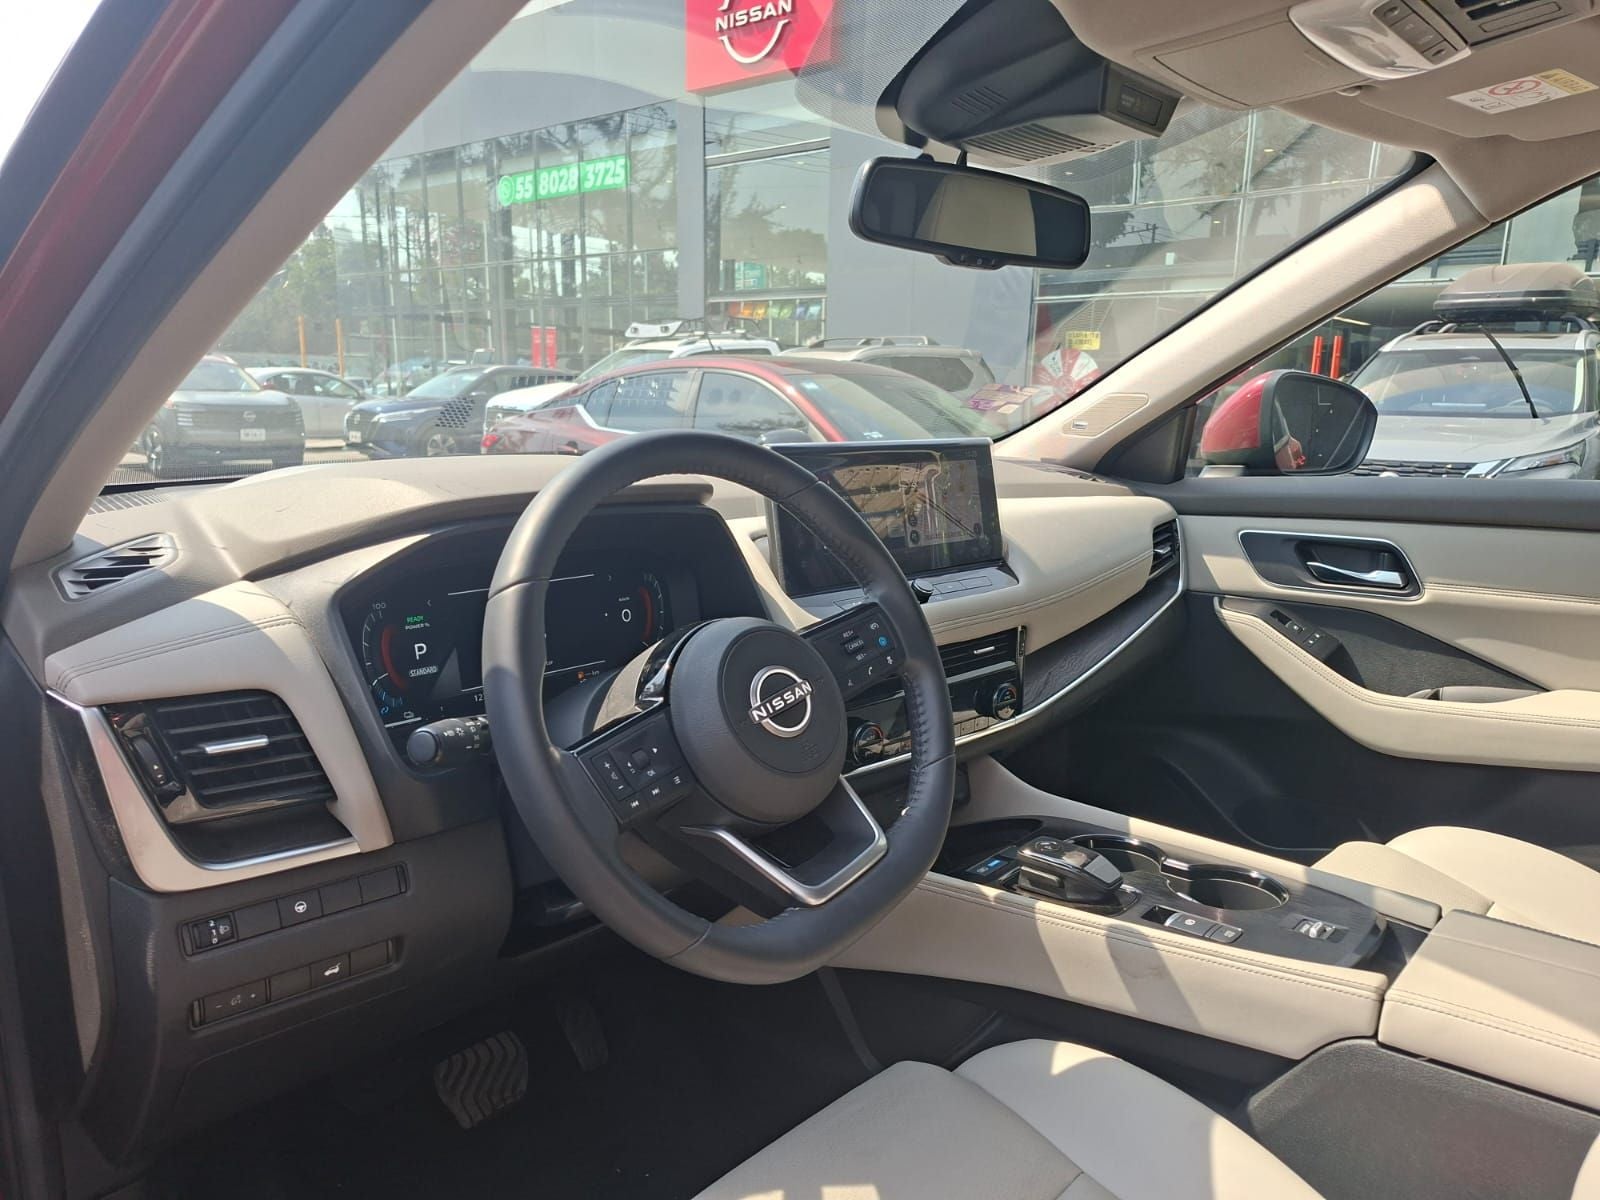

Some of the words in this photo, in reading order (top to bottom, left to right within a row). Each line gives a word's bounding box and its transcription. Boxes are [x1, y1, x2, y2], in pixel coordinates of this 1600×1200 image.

[715, 0, 792, 32] NISSAN
[515, 175, 533, 200] 55
[539, 166, 578, 195] 8028
[583, 158, 625, 188] 3725
[621, 608, 632, 622] 0
[414, 643, 427, 660] P
[752, 681, 812, 721] NISSAN
